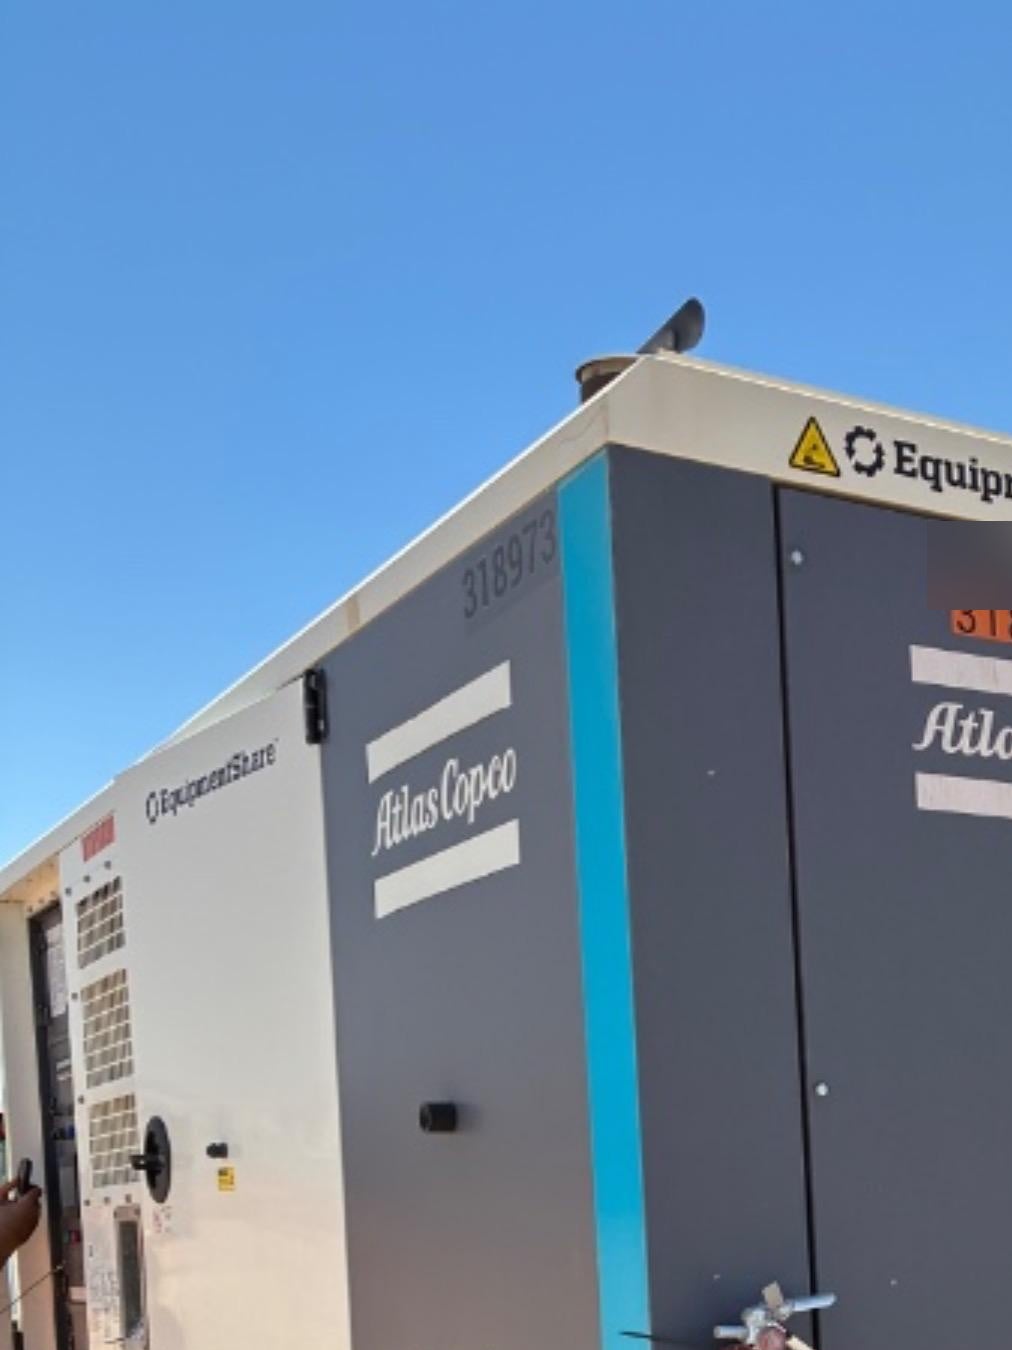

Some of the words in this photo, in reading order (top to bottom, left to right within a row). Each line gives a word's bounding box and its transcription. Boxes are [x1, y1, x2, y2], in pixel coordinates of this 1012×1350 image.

[461, 508, 556, 619] 318973
[160, 742, 277, 817] EquipmentShare
[371, 780, 439, 857] Atlas
[441, 747, 517, 825] Copco
